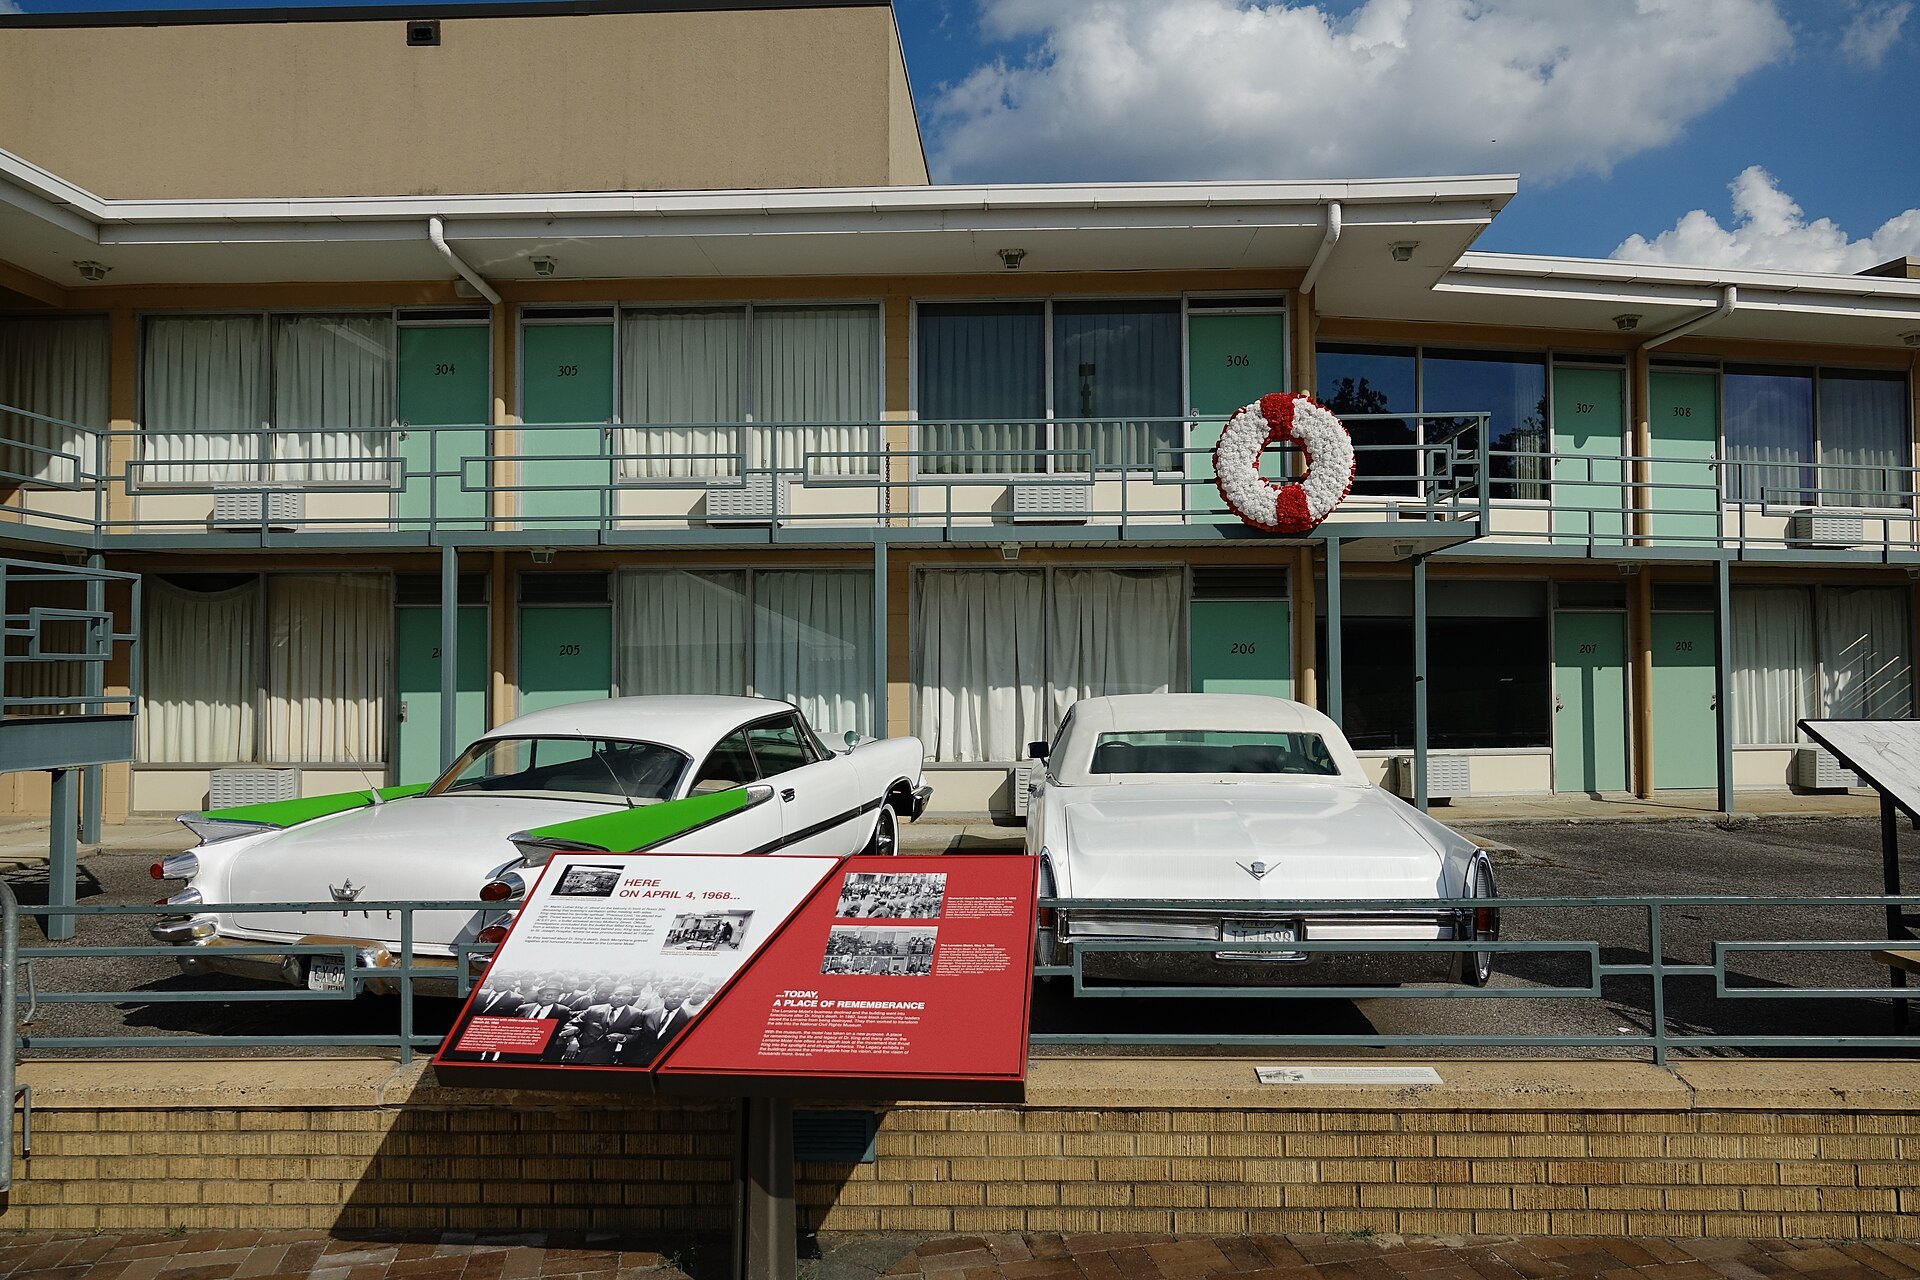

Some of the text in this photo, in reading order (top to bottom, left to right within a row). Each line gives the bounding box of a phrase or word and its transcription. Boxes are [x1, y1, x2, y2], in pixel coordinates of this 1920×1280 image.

[1226, 354, 1250, 367] 306
[434, 364, 455, 376] 304
[558, 365, 578, 377] 305
[1576, 403, 1594, 414] 307
[1673, 406, 1692, 417] 308
[559, 644, 580, 656] 205
[1230, 641, 1256, 655] 206
[1579, 644, 1597, 654] 207
[1675, 641, 1693, 651] 208
[623, 878, 661, 887] HERE
[619, 889, 741, 900] ON APRIL 4, 1968...
[776, 990, 818, 999] ...TODAY,
[784, 1000, 818, 1008] PLACE
[837, 1001, 925, 1010] REMEMBERANCE
